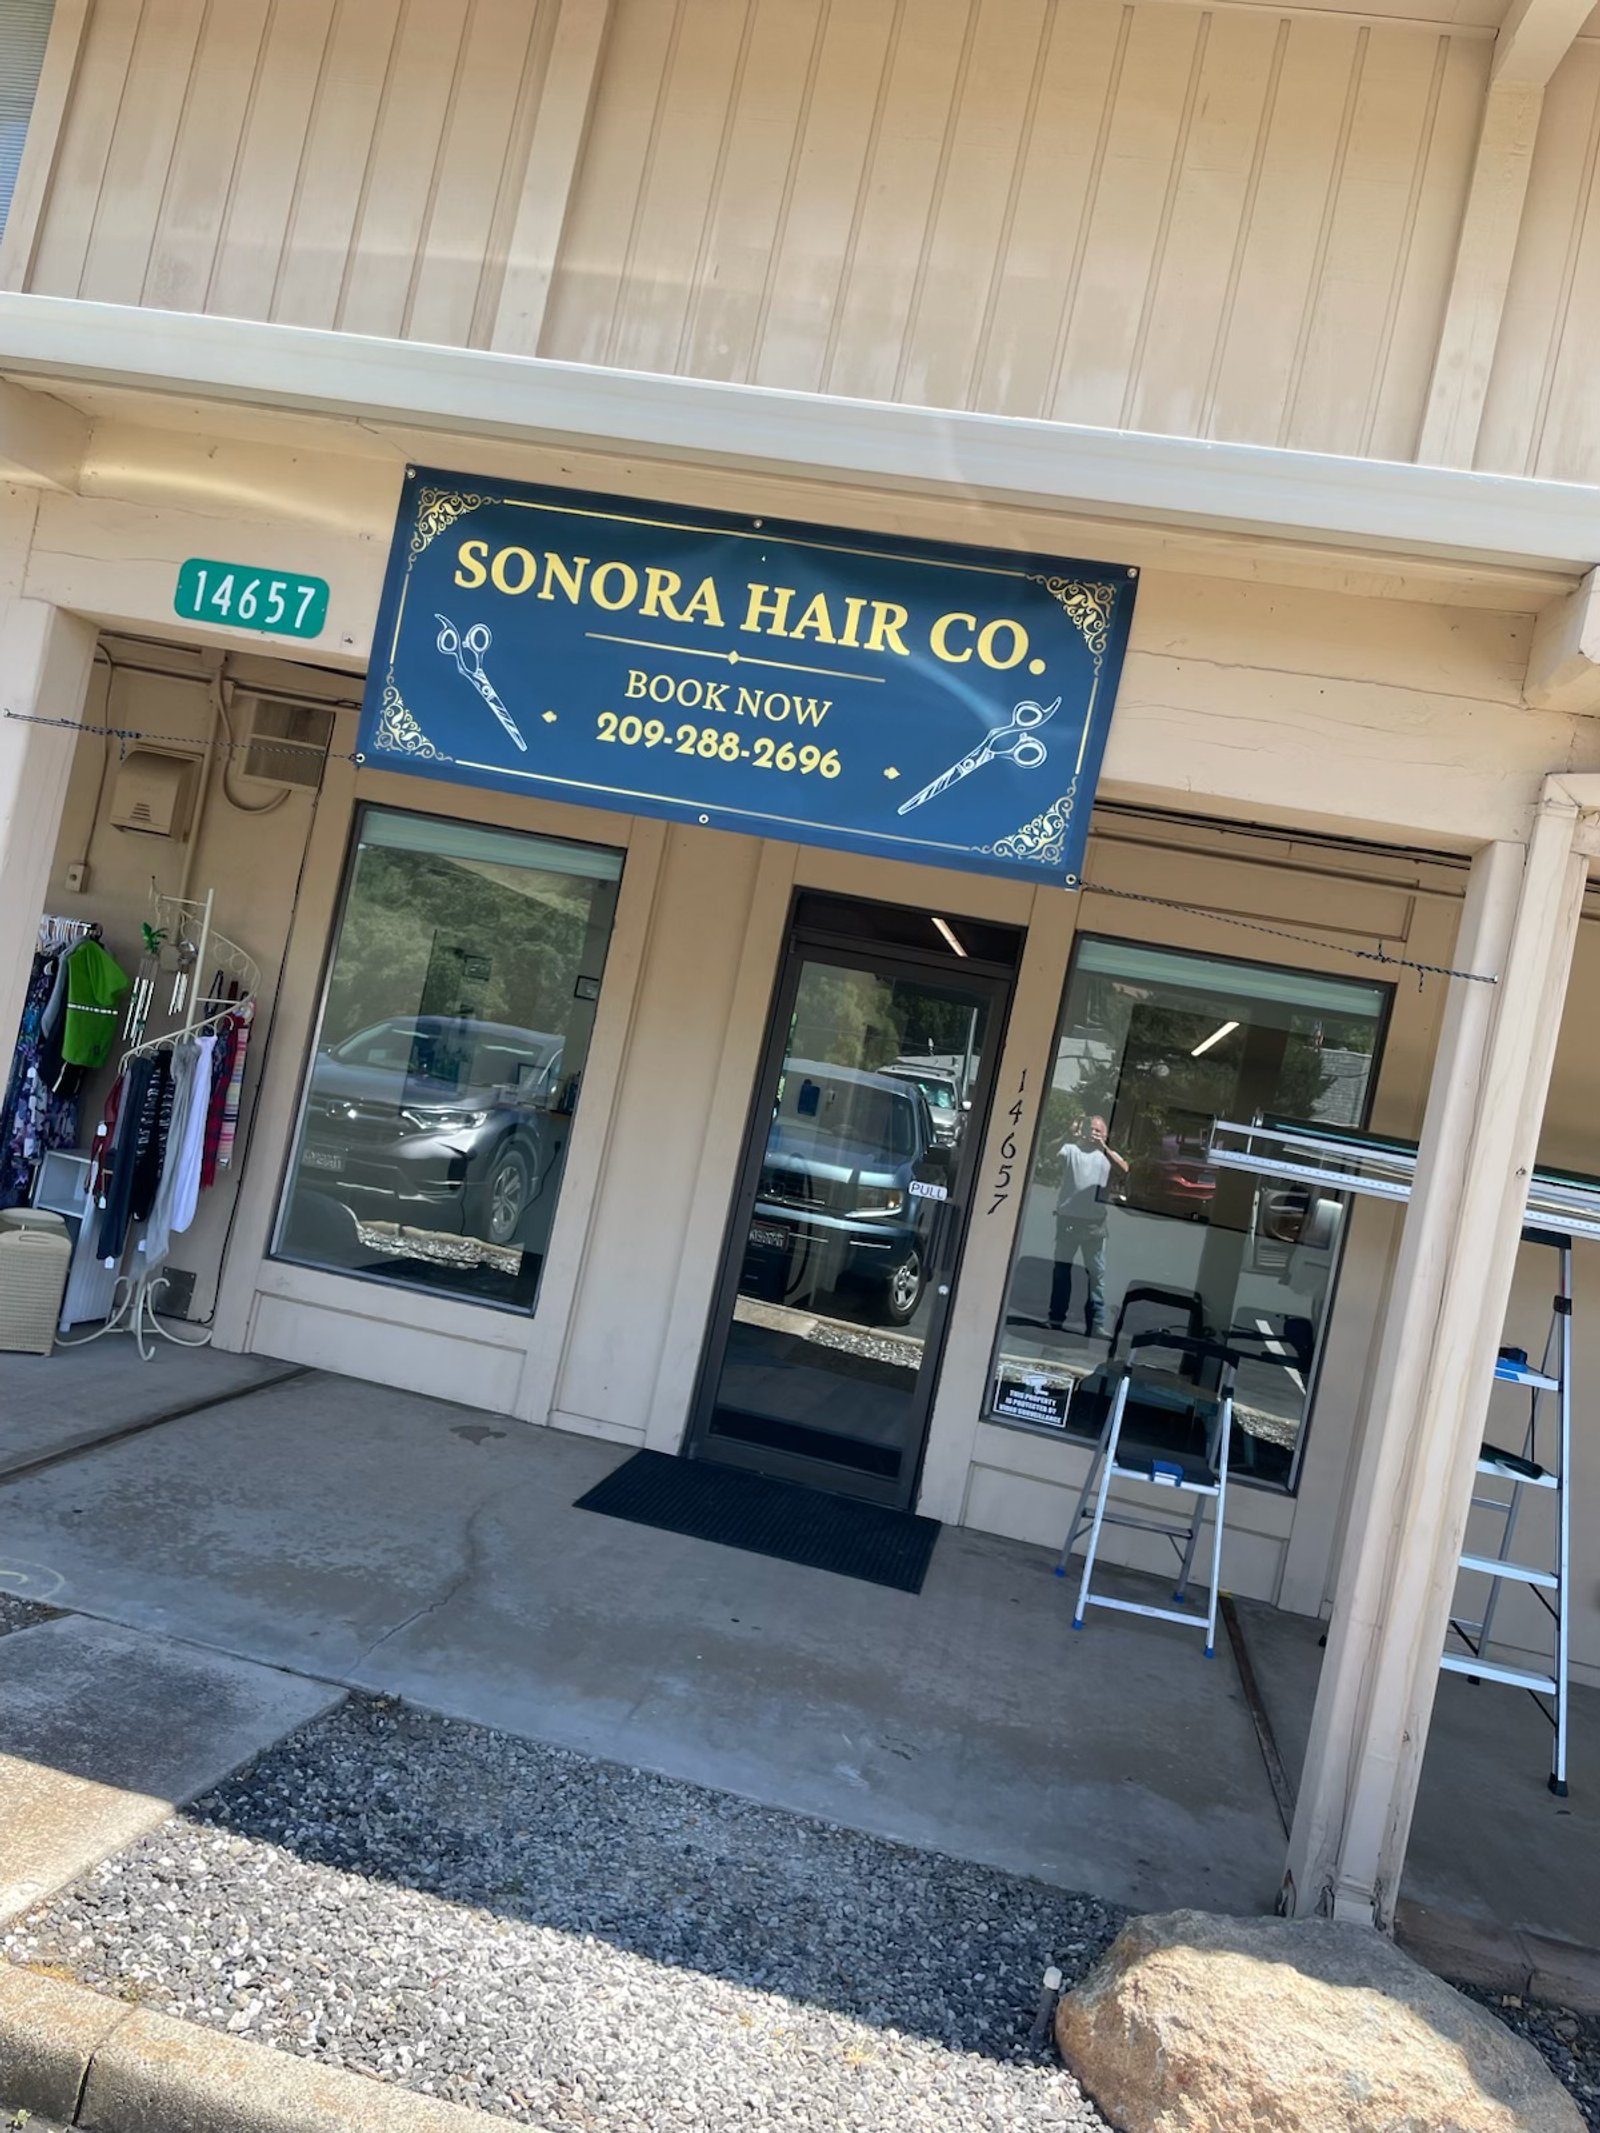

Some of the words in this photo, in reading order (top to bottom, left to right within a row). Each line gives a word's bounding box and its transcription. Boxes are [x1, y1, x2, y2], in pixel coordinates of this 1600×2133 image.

[194, 570, 316, 629] 14657
[454, 540, 725, 627] SONORA
[740, 583, 910, 656] HAIR
[929, 612, 1046, 675] CO.
[624, 669, 730, 712] BOOK
[734, 687, 832, 728] NOW
[596, 711, 841, 779] 209-288-2696
[911, 1182, 944, 1199] PULL
[999, 1403, 1017, 1414] VIDEO
[1017, 1408, 1062, 1424] SURVEILLANCE
[1009, 1389, 1025, 1399] THIS
[1025, 1393, 1056, 1407] PROPERTY
[1013, 1398, 1048, 1413] PROTECTED
[1048, 1406, 1057, 1415] BY
